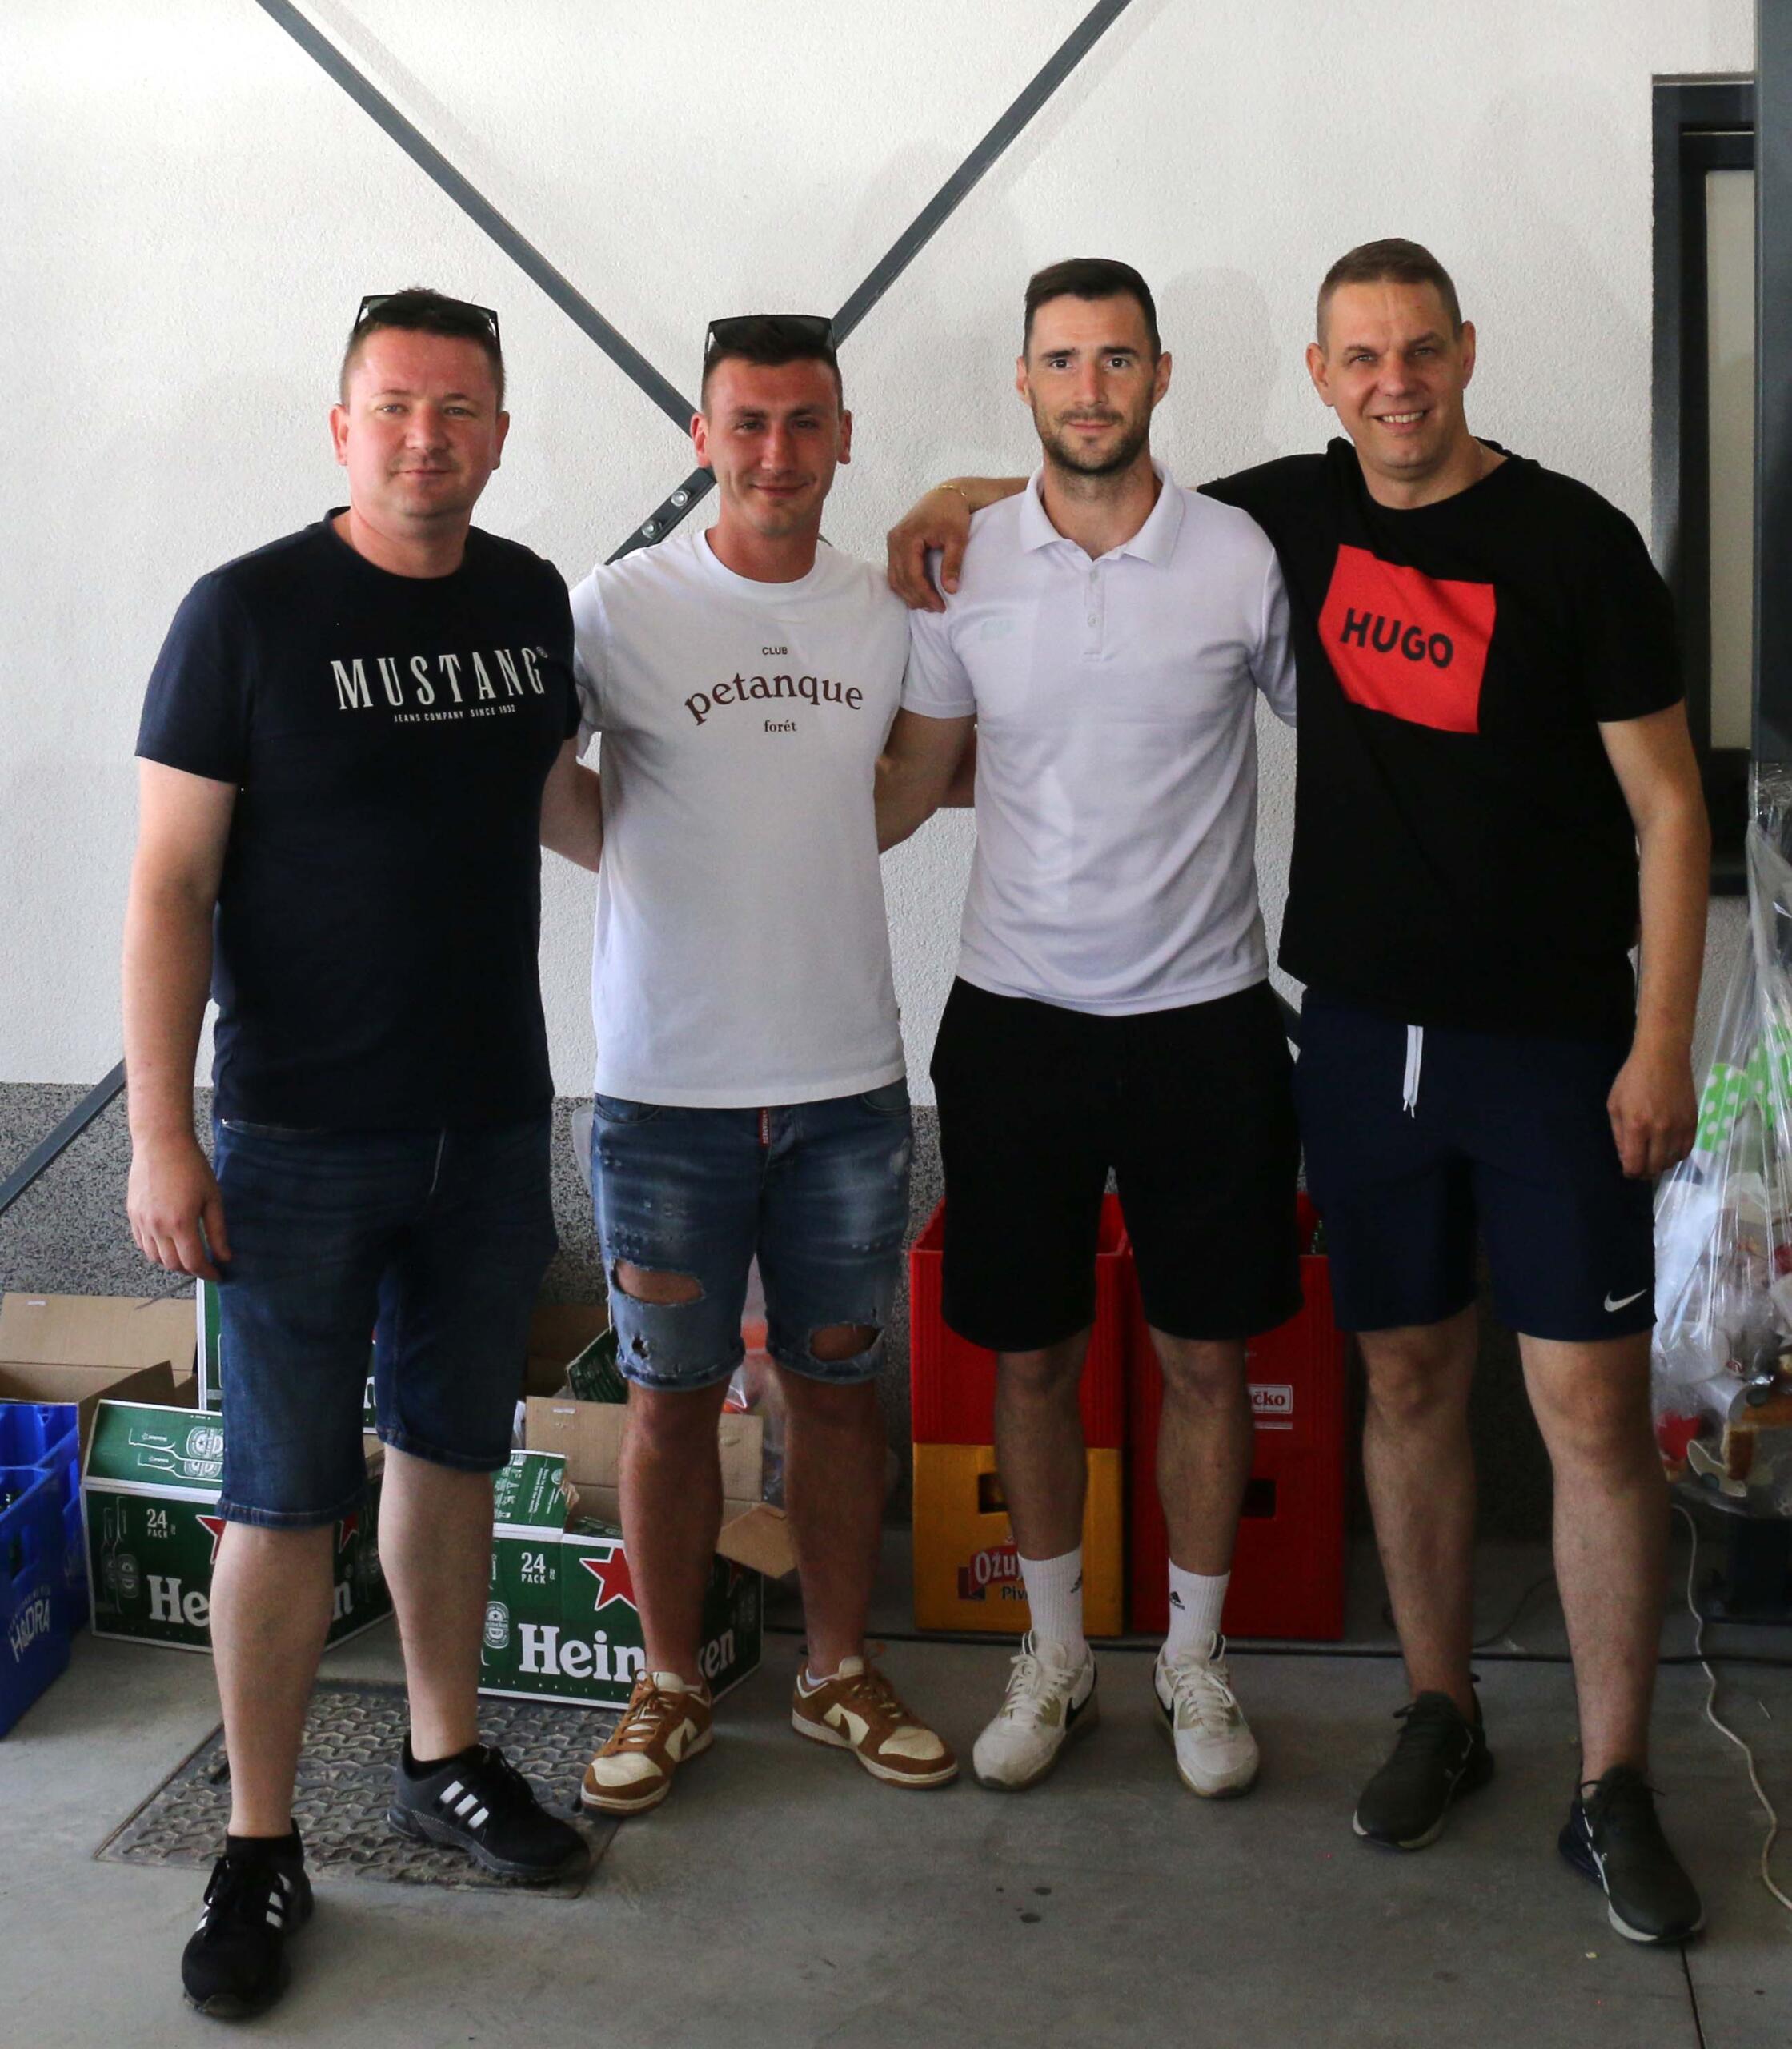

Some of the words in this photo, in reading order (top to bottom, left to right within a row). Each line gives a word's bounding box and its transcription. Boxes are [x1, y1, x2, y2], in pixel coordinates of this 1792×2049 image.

[1339, 607, 1454, 669] HUGO
[761, 647, 788, 656] CLUB
[329, 647, 545, 711] MUSTANG
[684, 672, 864, 726] petanque
[394, 713, 421, 722] JEANS
[424, 711, 464, 721] COMPANY
[469, 707, 496, 717] SINCE
[499, 704, 516, 714] 1932
[146, 1508, 168, 1530] 24
[147, 1528, 168, 1538] PACK
[521, 1552, 547, 1574] 24
[521, 1574, 547, 1584] PACK
[1002, 1585, 1028, 1600] Piv
